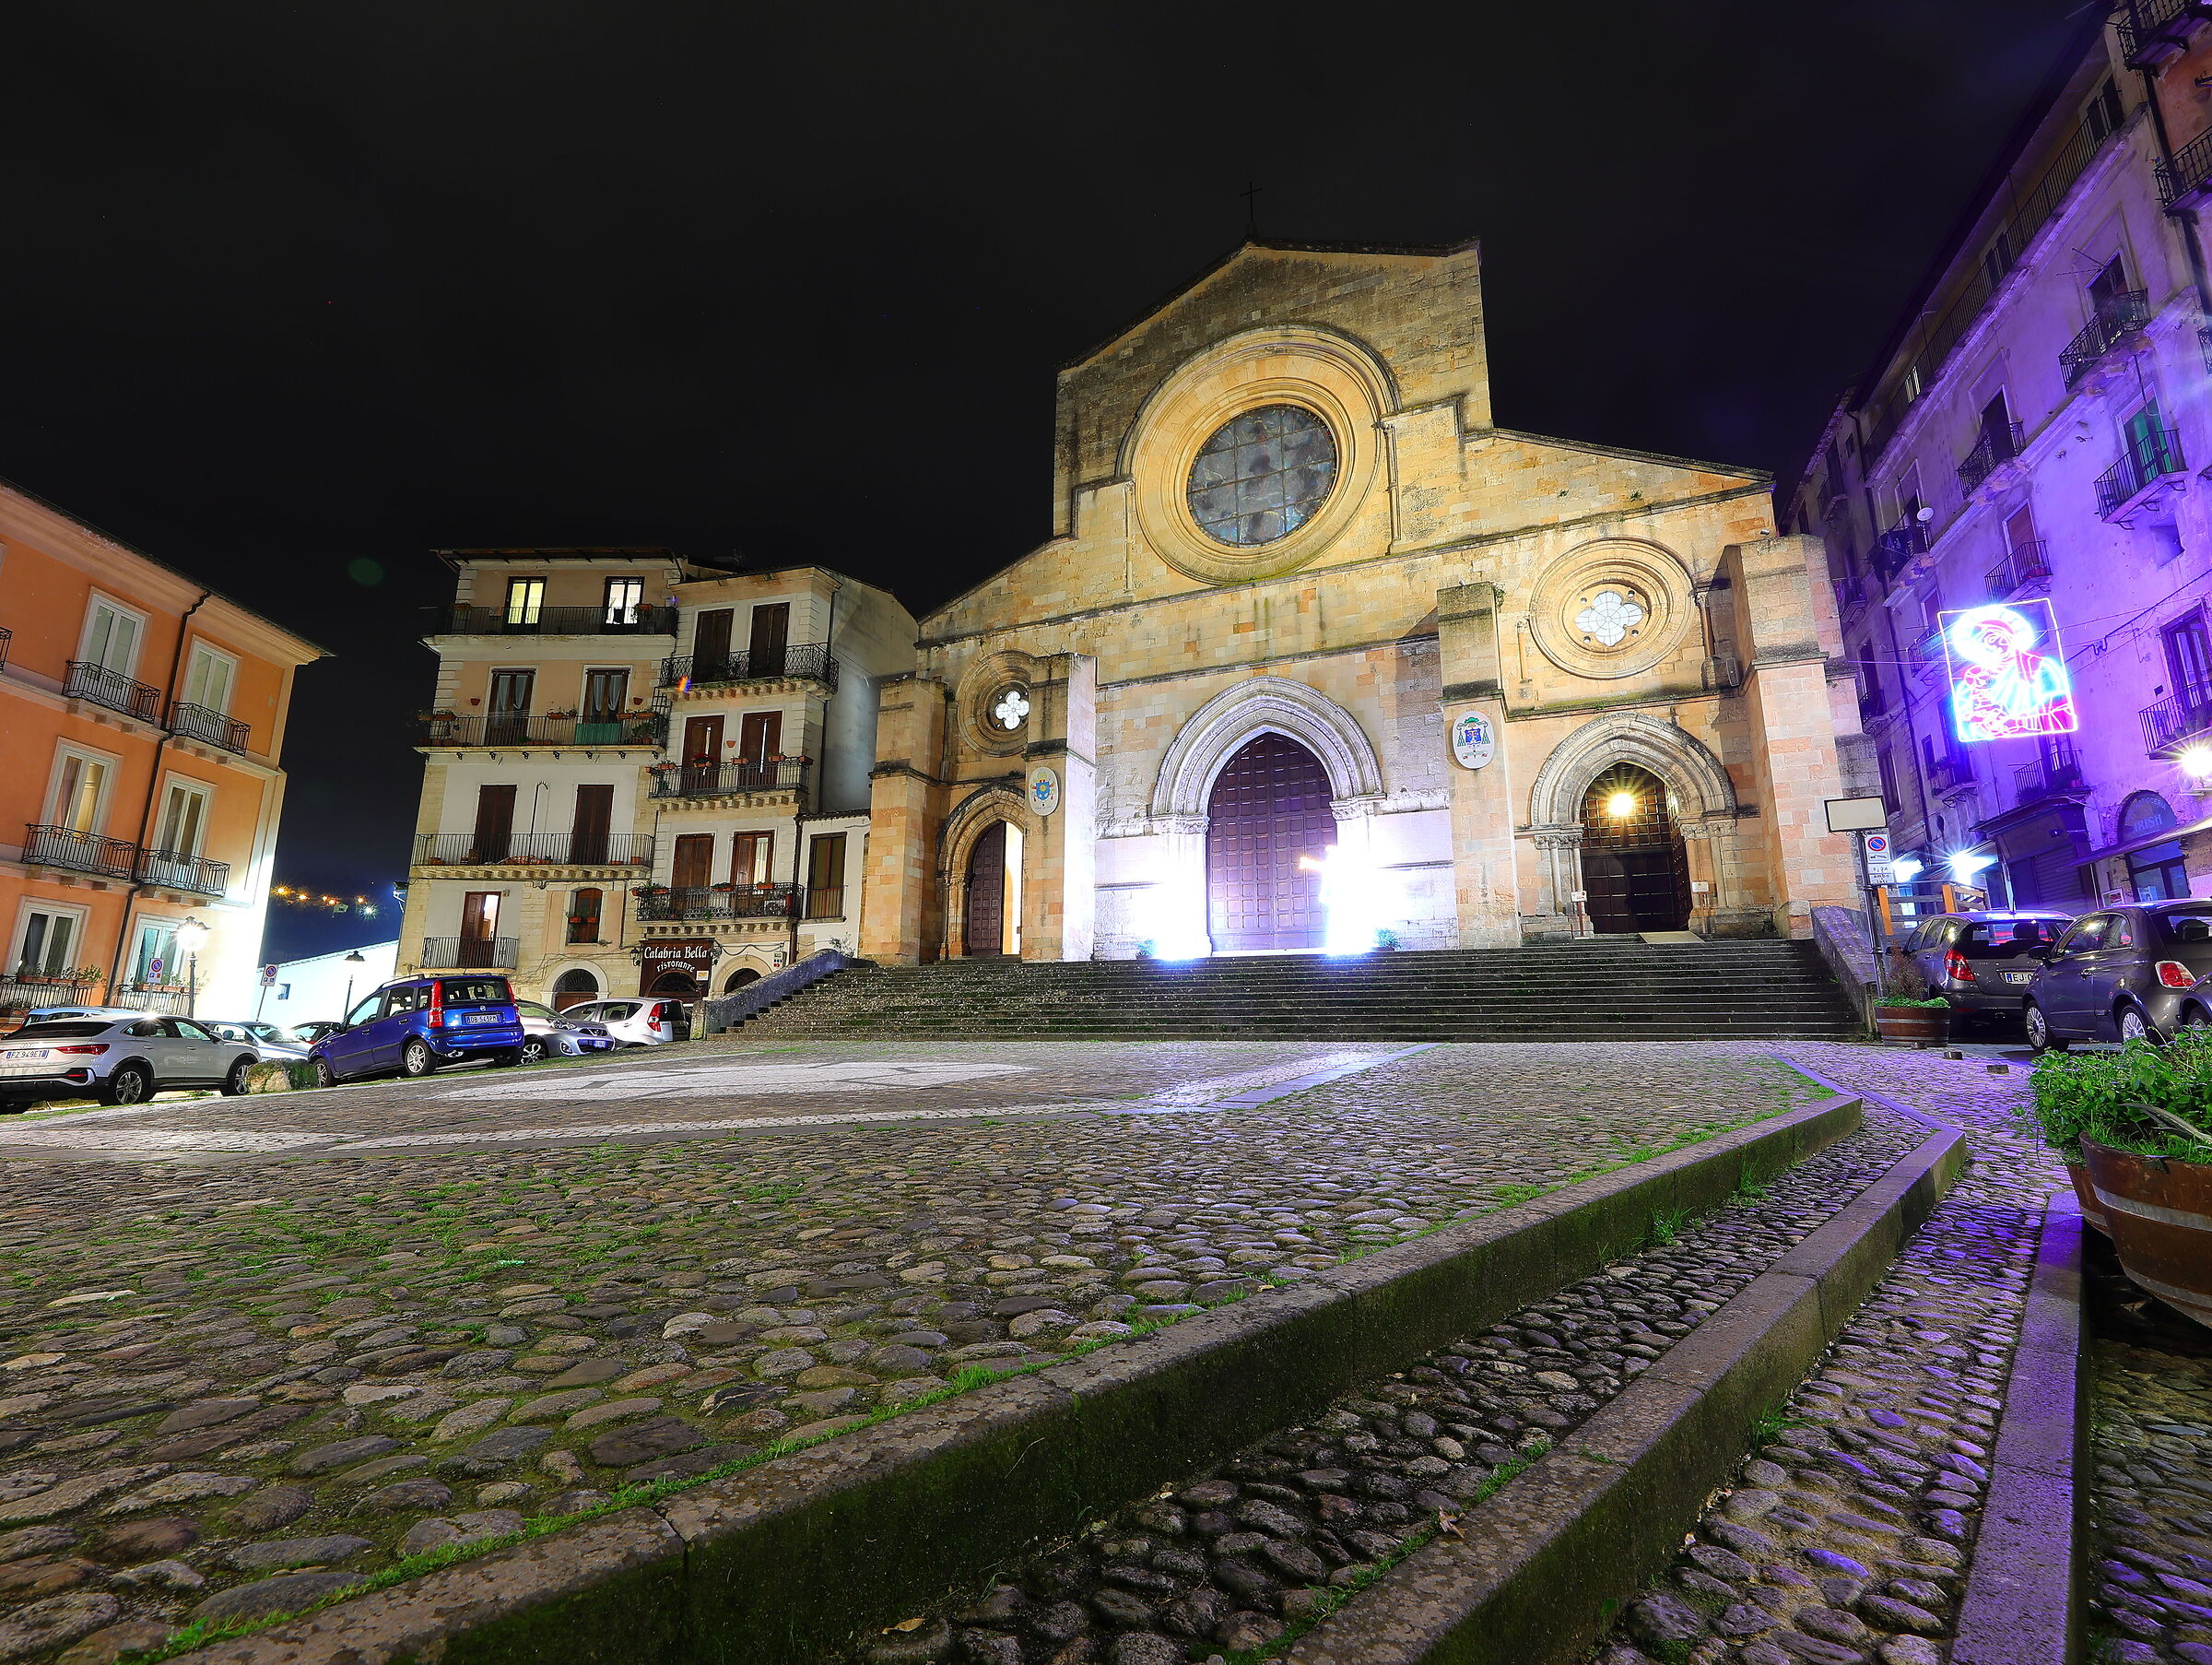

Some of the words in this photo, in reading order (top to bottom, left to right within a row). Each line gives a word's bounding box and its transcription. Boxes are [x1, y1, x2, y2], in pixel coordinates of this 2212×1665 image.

[2134, 814, 2162, 832] IRISH
[644, 946, 681, 959] Calabria
[684, 945, 708, 959] Bella
[656, 960, 696, 973] ristorante
